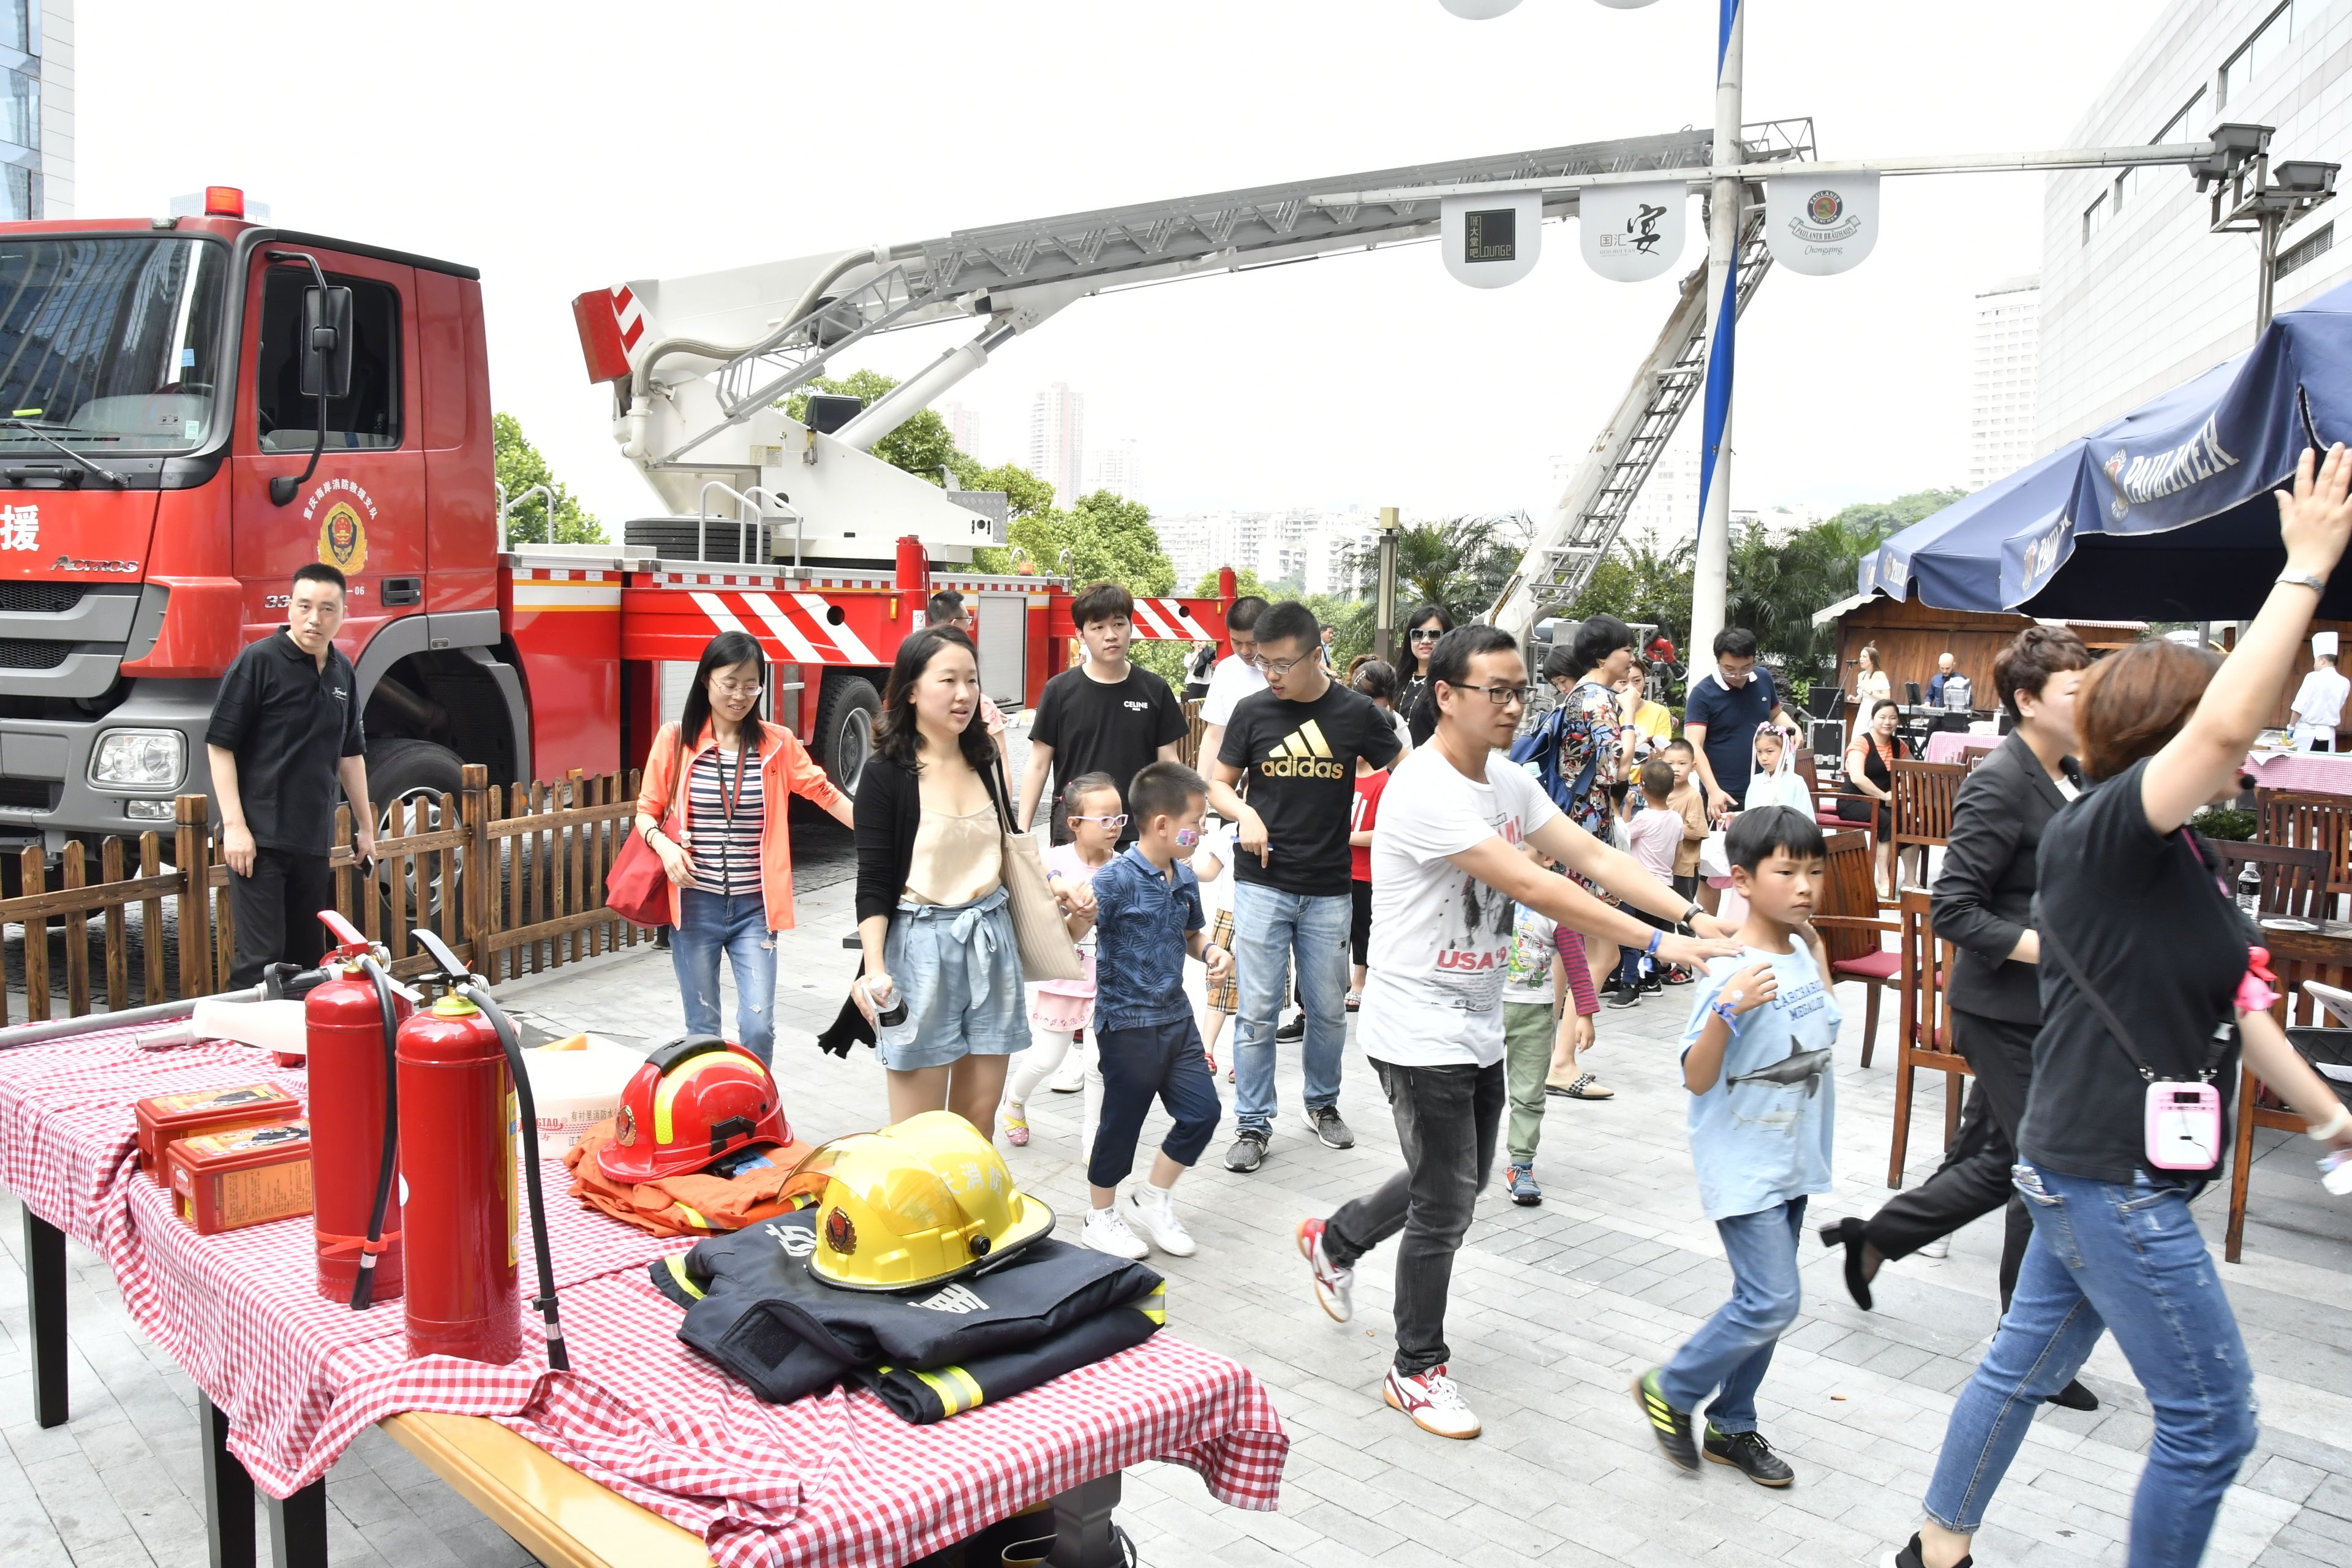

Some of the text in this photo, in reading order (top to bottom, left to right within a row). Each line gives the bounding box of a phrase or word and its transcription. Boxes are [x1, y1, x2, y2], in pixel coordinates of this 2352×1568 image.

[1809, 190, 1841, 205] PAULANER
[1469, 226, 1479, 258] 大堂吧
[1600, 233, 1627, 247] 国汇
[1795, 227, 1823, 240] PAULANER
[1804, 245, 1843, 255] Chongqing
[2124, 411, 2240, 504] PAULANER
[303, 478, 379, 521] 重庆南岸消防救援支队
[0, 504, 40, 551] 援
[1123, 700, 1148, 709] CELINE
[1261, 755, 1344, 780] adidas
[1436, 949, 1494, 970] USA
[570, 1107, 617, 1123] 有衬里消防水
